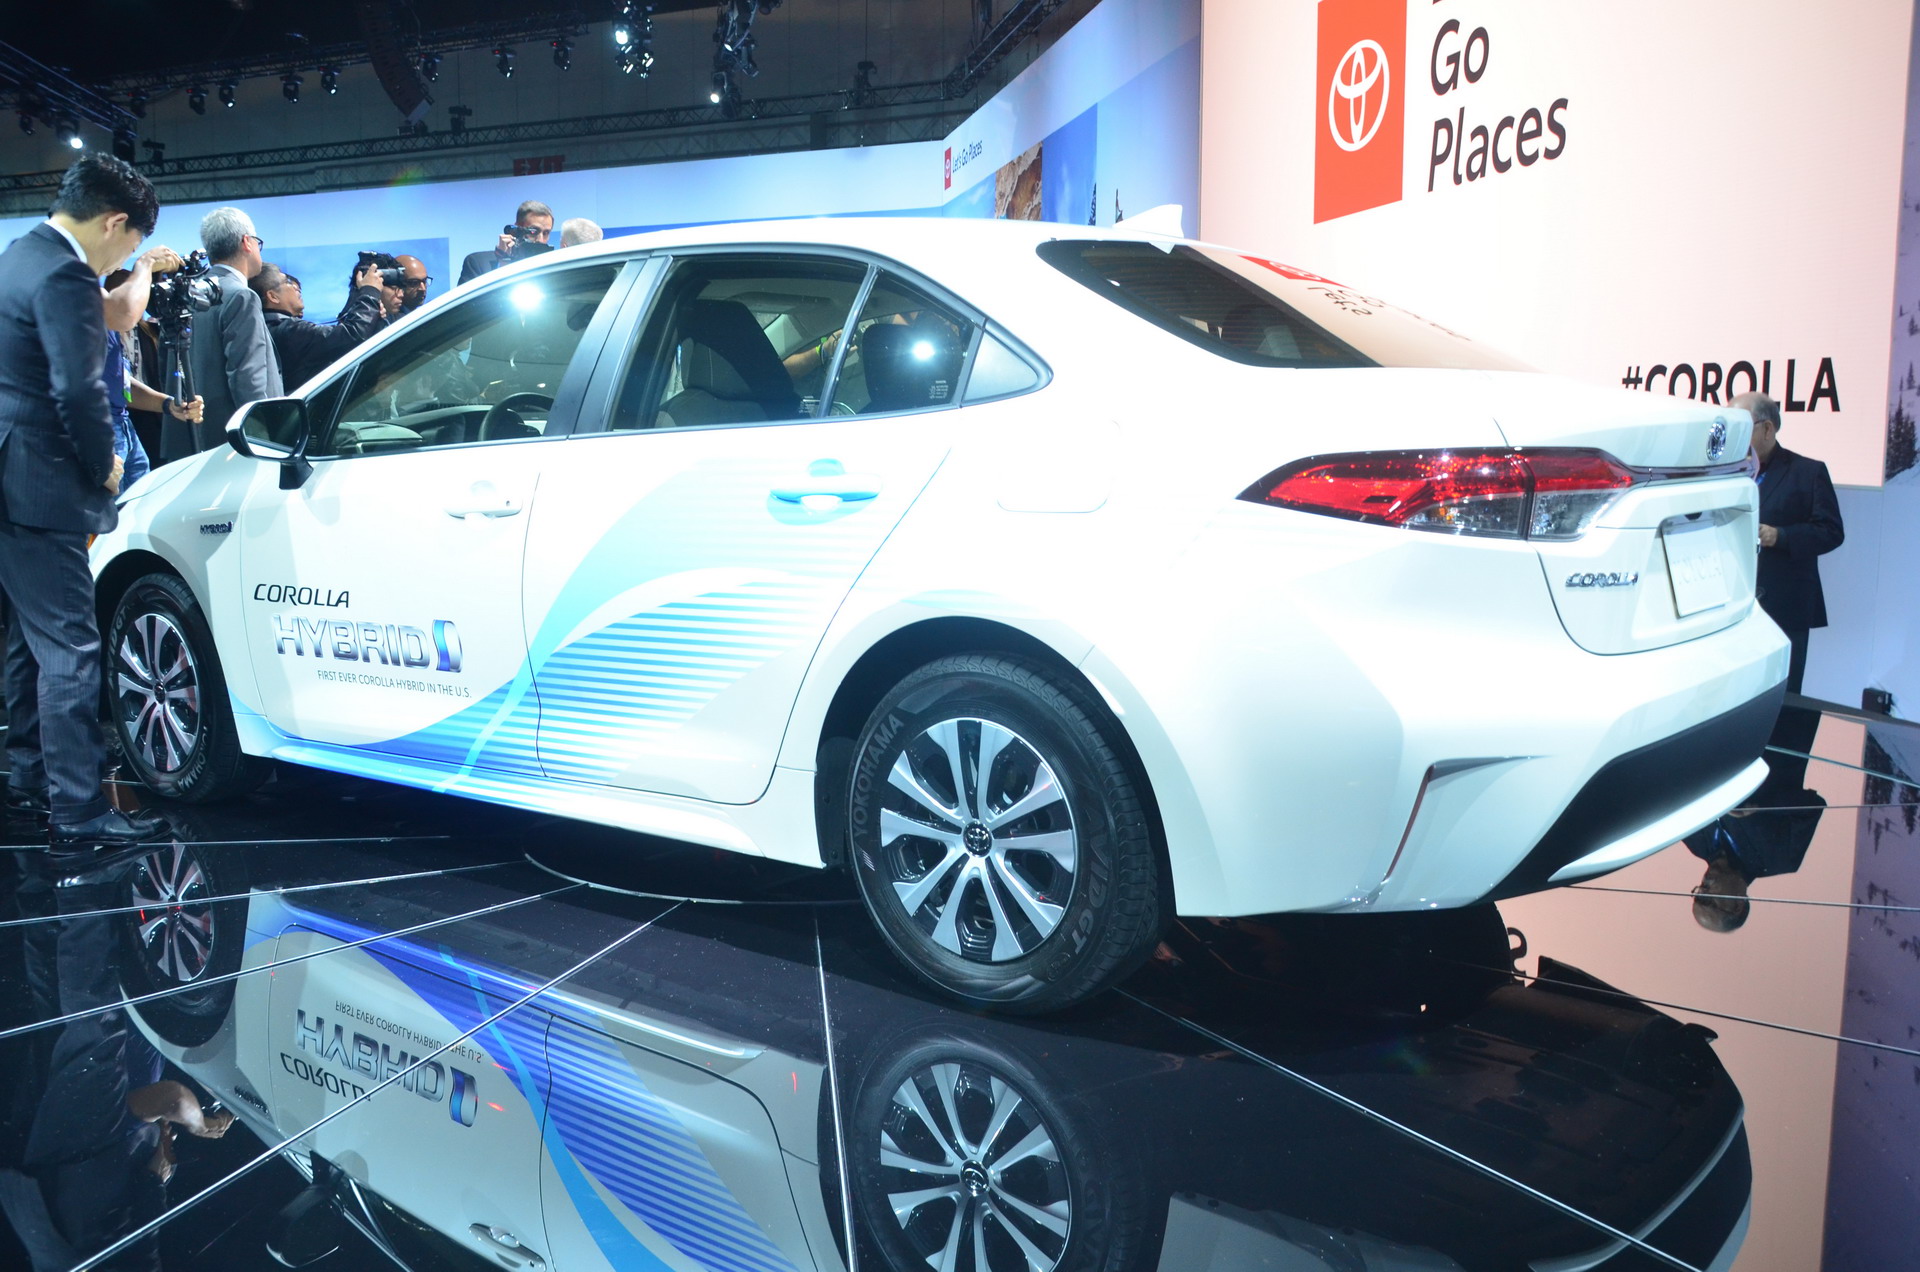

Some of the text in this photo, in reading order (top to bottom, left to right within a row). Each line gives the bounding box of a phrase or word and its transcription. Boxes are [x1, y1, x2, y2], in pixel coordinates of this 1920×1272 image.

[1431, 18, 1490, 96] Go
[962, 148, 969, 166] Go
[1428, 97, 1569, 193] Places
[513, 155, 566, 176] EXIT
[1565, 572, 1639, 588] COROLLA
[253, 583, 350, 608] COROLLA
[271, 613, 431, 669] HYBRID
[317, 670, 472, 698] FIRST EVER COROLLA HYBRID IN THE U.S.
[852, 713, 905, 838] YOKOHAMA
